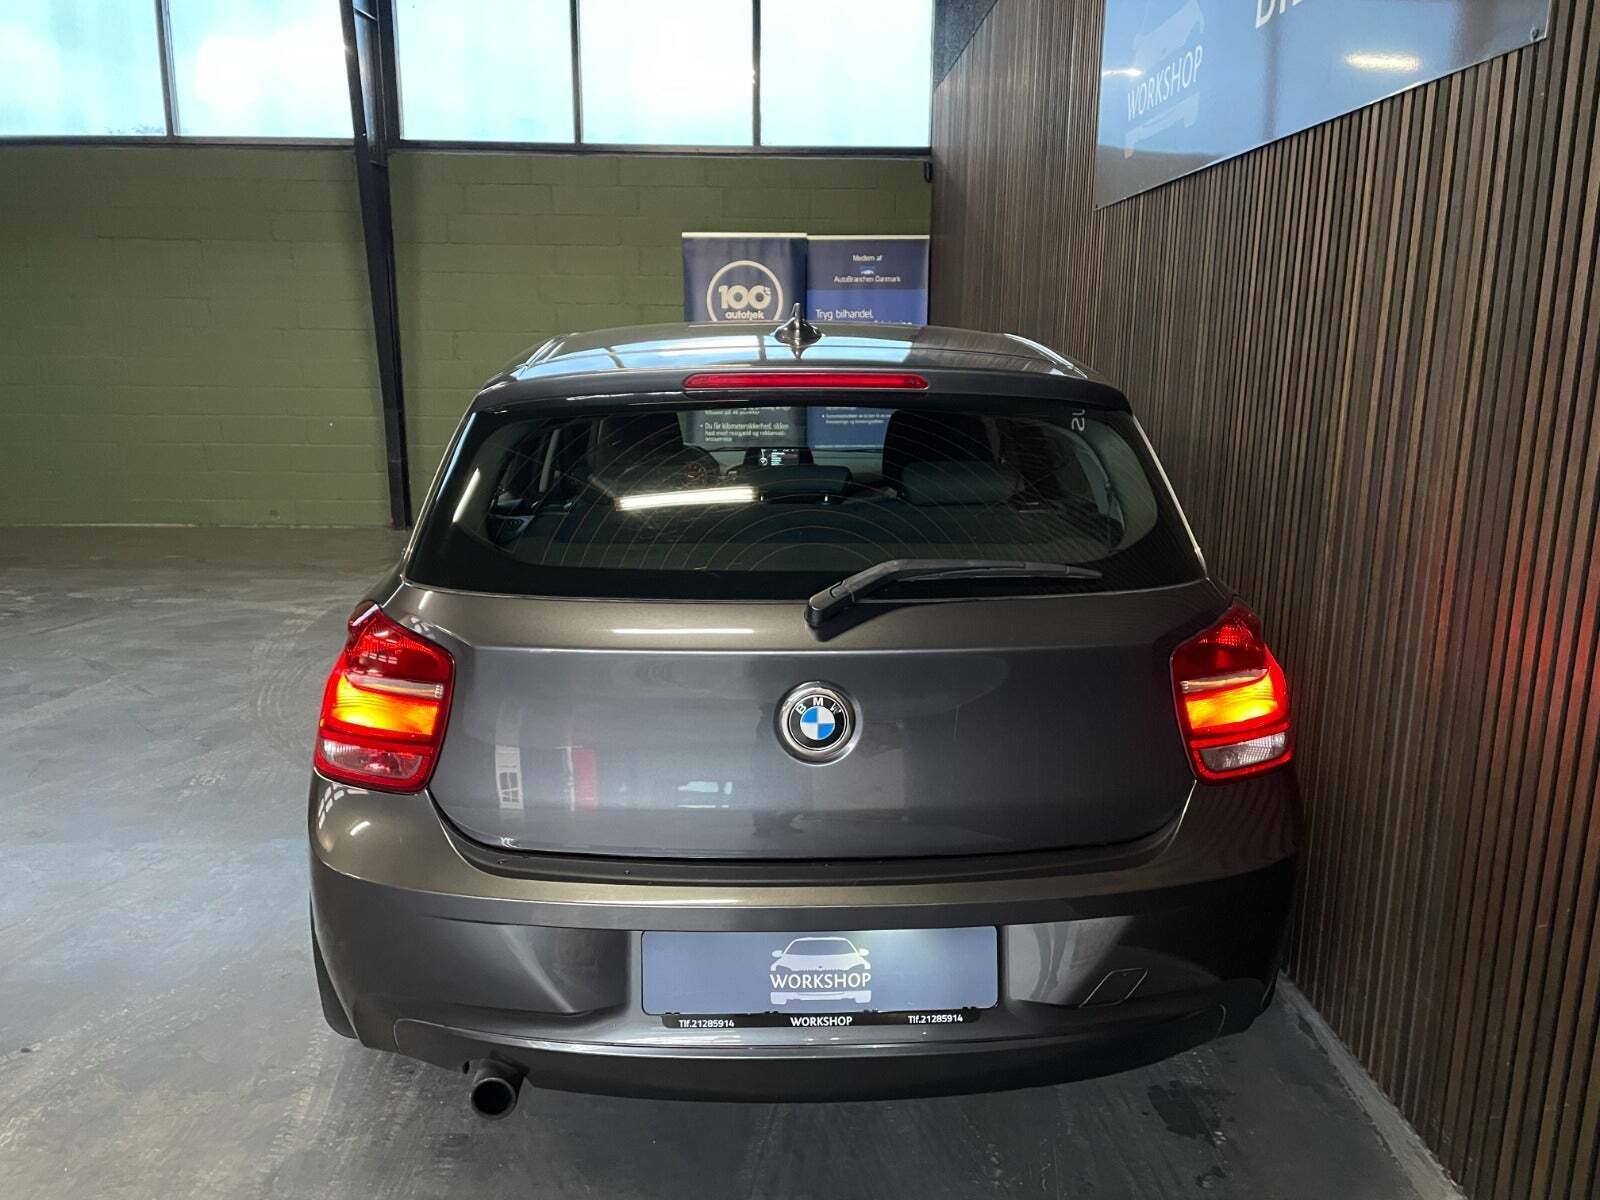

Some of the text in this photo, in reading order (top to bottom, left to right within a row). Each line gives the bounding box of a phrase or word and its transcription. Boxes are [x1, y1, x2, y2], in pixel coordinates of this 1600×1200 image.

[1127, 45, 1204, 121] WORKSHOP
[834, 274, 901, 283] AutoBranchen Danmark
[815, 309, 833, 320] Tryg
[704, 422, 713, 430] Du
[770, 972, 872, 990] WORKSHOP
[678, 1013, 964, 1029] Tlf.21285914 WORKSHOP Tlf.21285914
